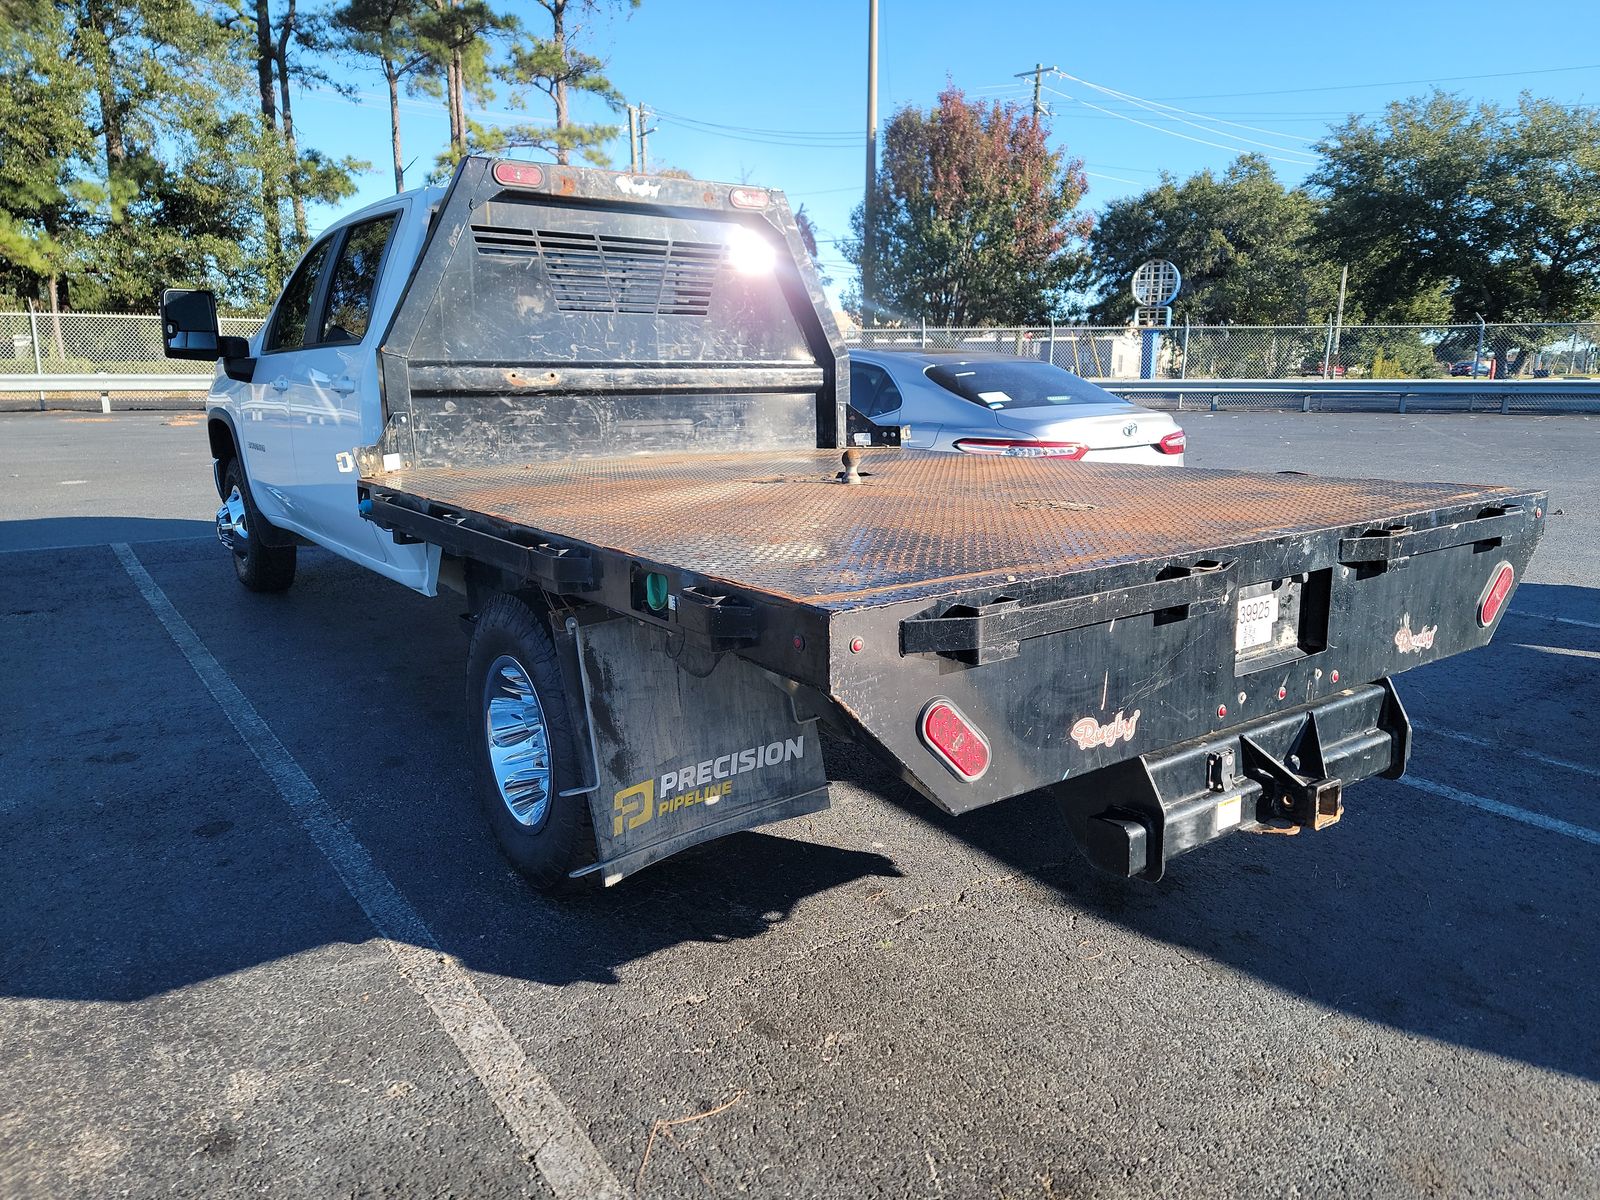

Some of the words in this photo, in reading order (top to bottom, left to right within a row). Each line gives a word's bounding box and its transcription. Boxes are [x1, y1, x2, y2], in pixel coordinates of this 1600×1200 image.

[1240, 601, 1270, 624] 39925
[1070, 709, 1141, 750] Rugby
[660, 736, 804, 798] PRECISION
[658, 780, 733, 817] PIPELINE
